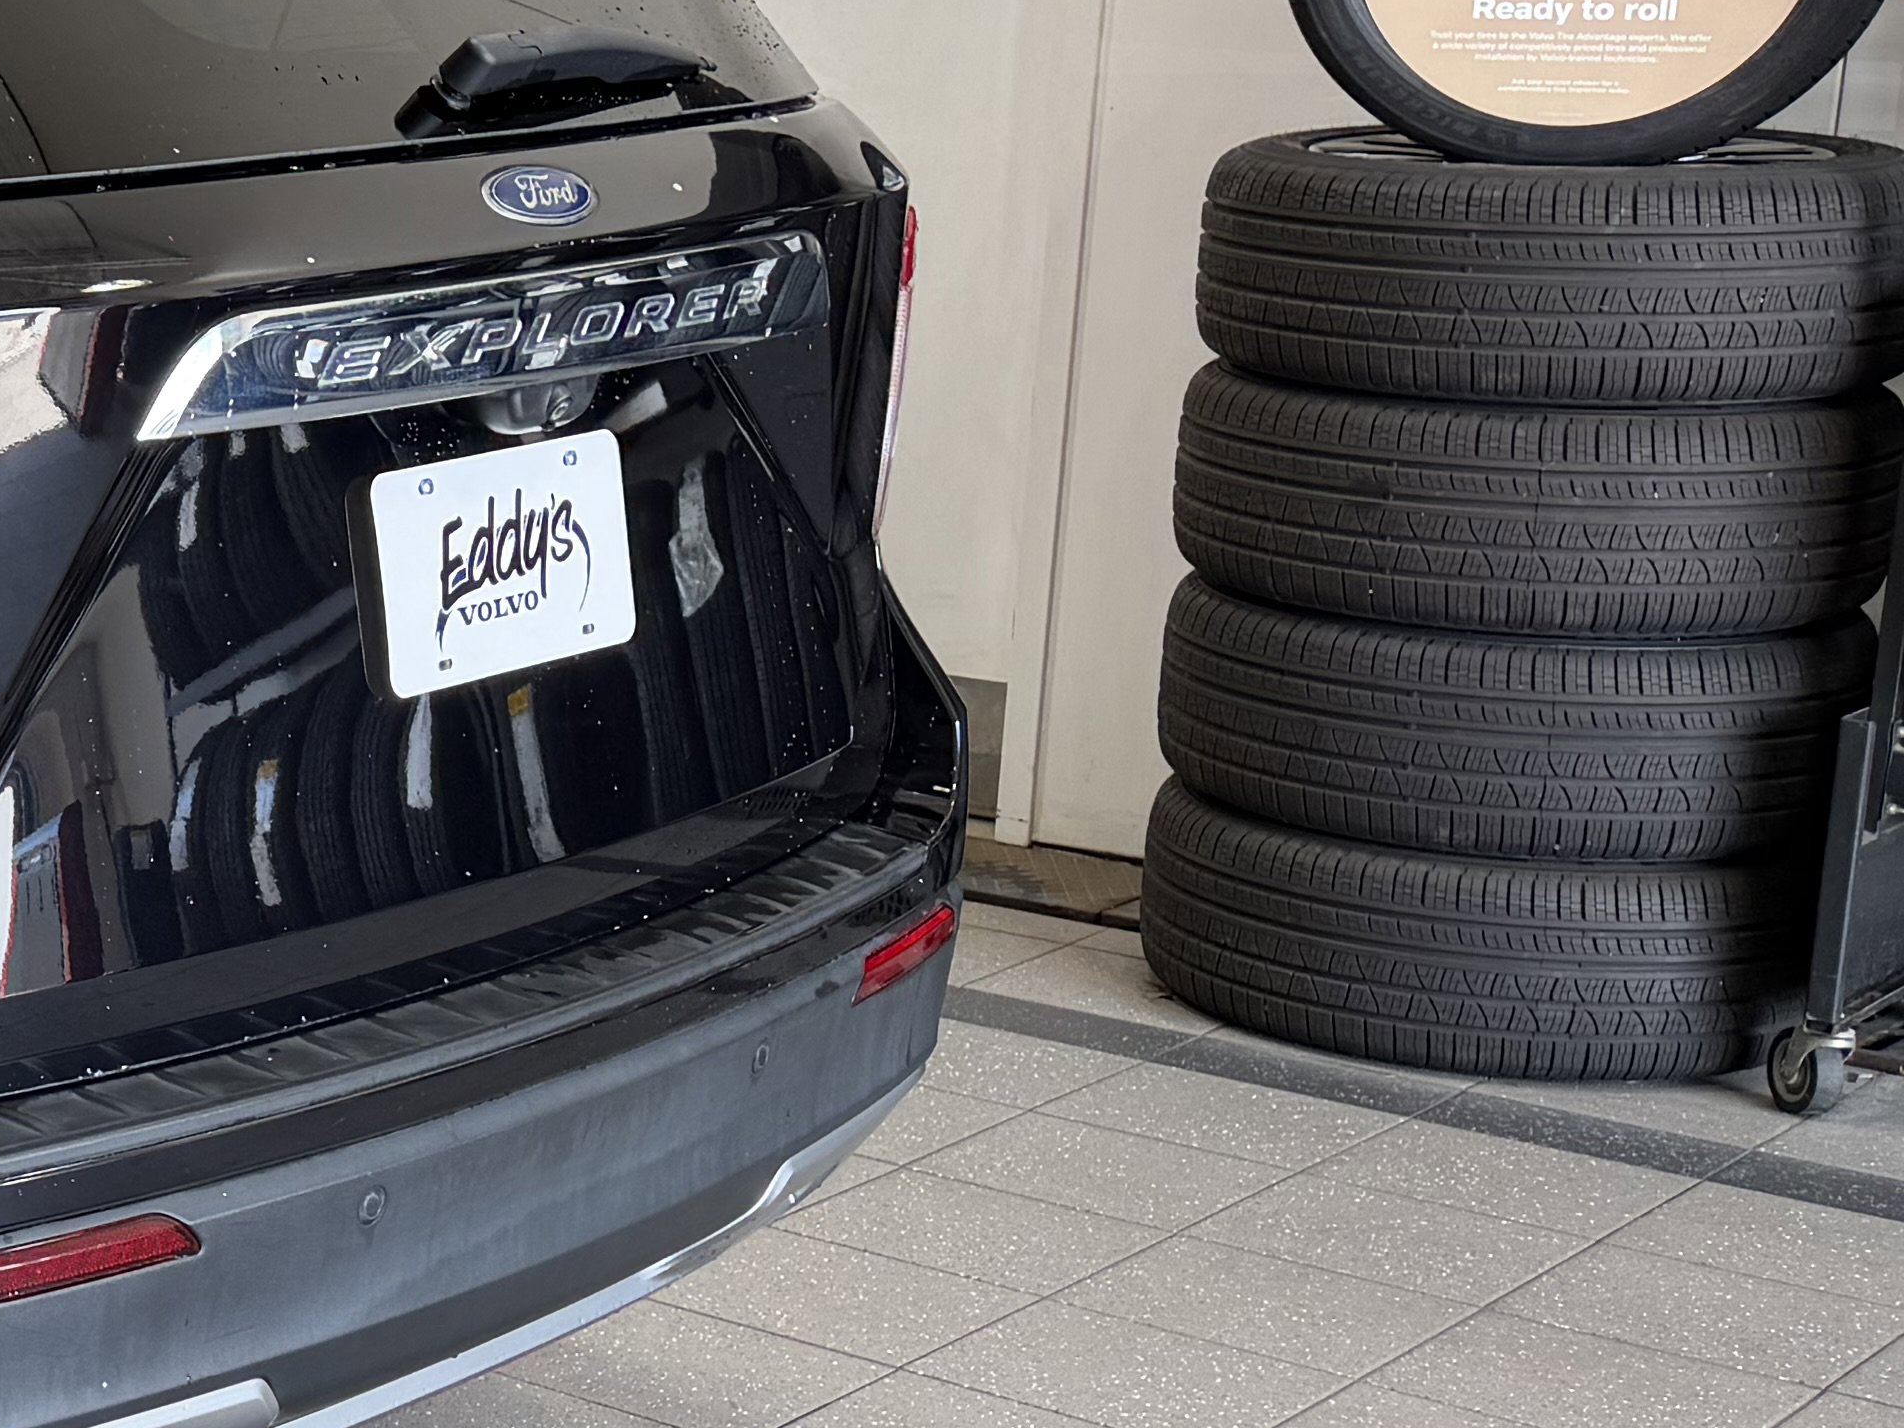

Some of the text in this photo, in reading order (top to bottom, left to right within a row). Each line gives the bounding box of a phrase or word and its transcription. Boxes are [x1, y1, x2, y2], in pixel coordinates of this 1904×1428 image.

[1454, 31, 1474, 42] your
[1498, 31, 1509, 40] to
[1511, 31, 1527, 40] the
[1528, 32, 1555, 41] Volvo
[1575, 33, 1628, 43] Advantage
[1670, 33, 1687, 42] We
[1688, 33, 1712, 43] offer
[1465, 42, 1496, 52] variety
[1628, 43, 1647, 53] and
[1526, 53, 1538, 63] by
[514, 173, 578, 209] Ford
[318, 275, 769, 388] EXPLORER
[440, 488, 574, 611] Eddy's
[457, 590, 539, 626] VOLVO
